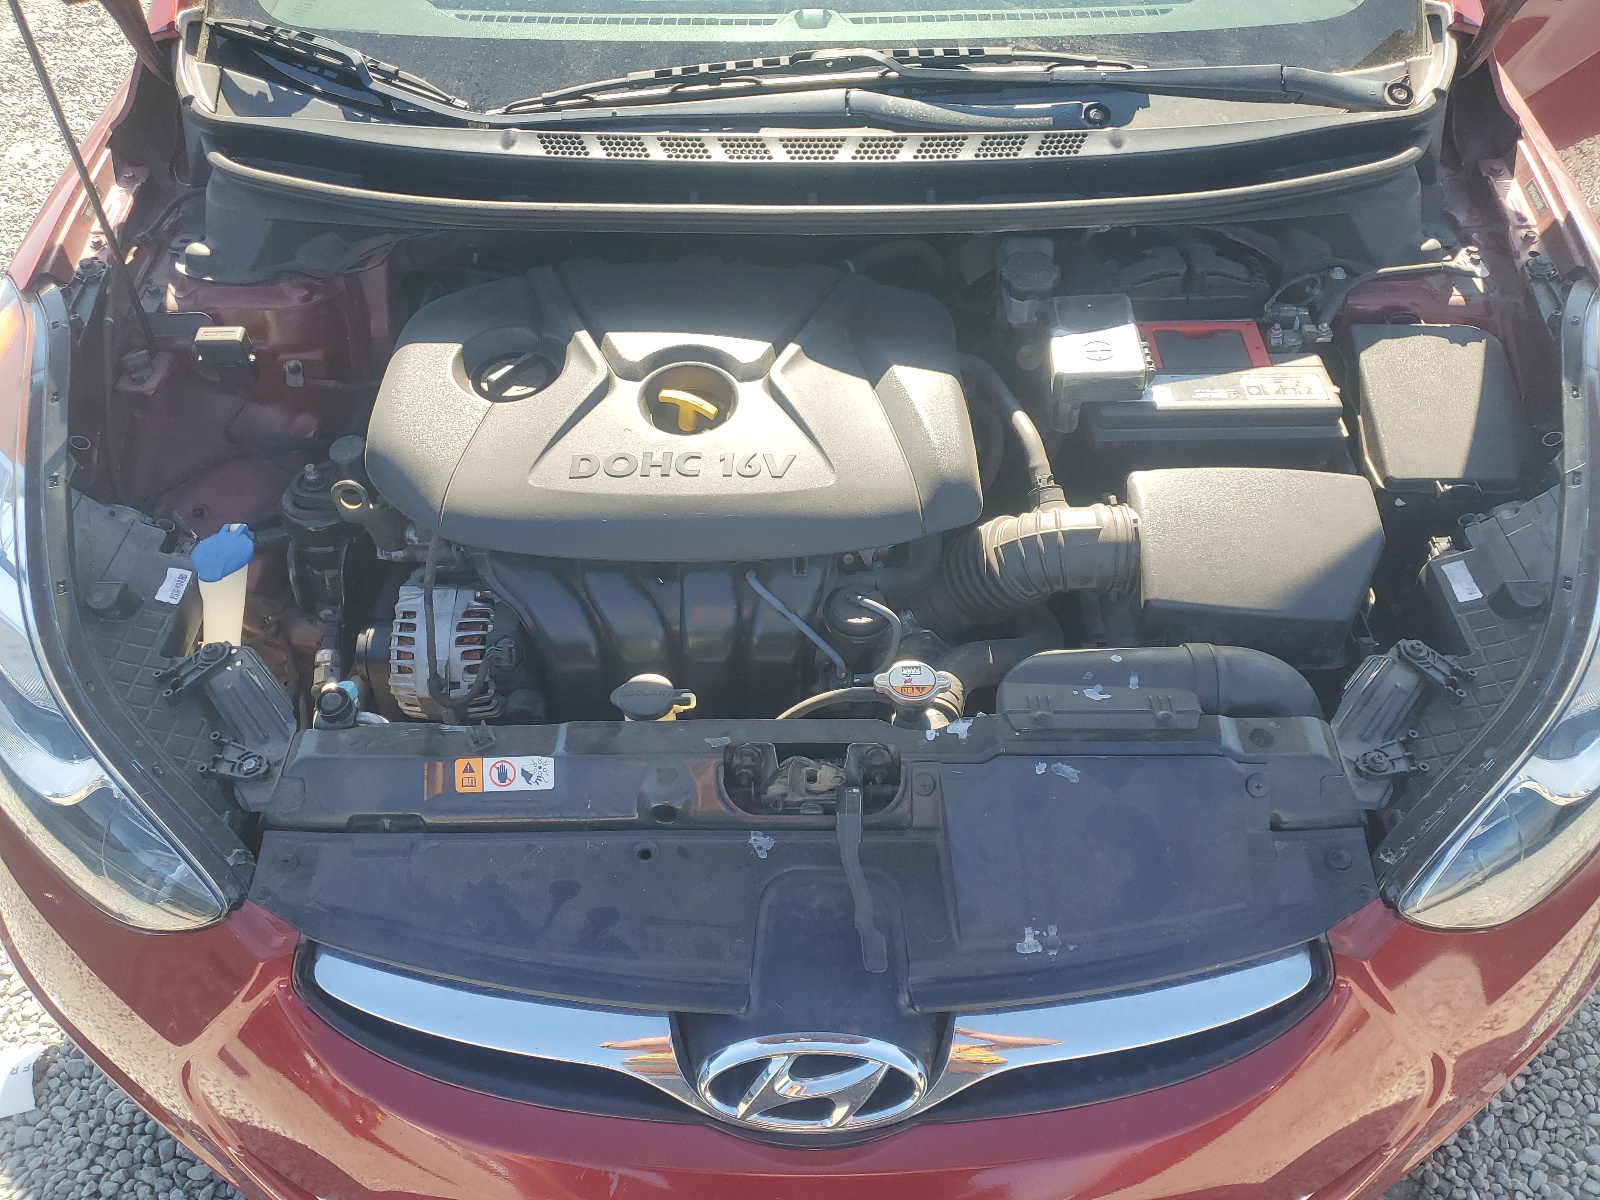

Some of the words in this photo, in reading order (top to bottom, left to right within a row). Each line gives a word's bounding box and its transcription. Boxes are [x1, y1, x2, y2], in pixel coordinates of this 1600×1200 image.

[569, 452, 702, 479] DOHC
[719, 452, 797, 479] 16V
[621, 689, 674, 698] COOLANT
